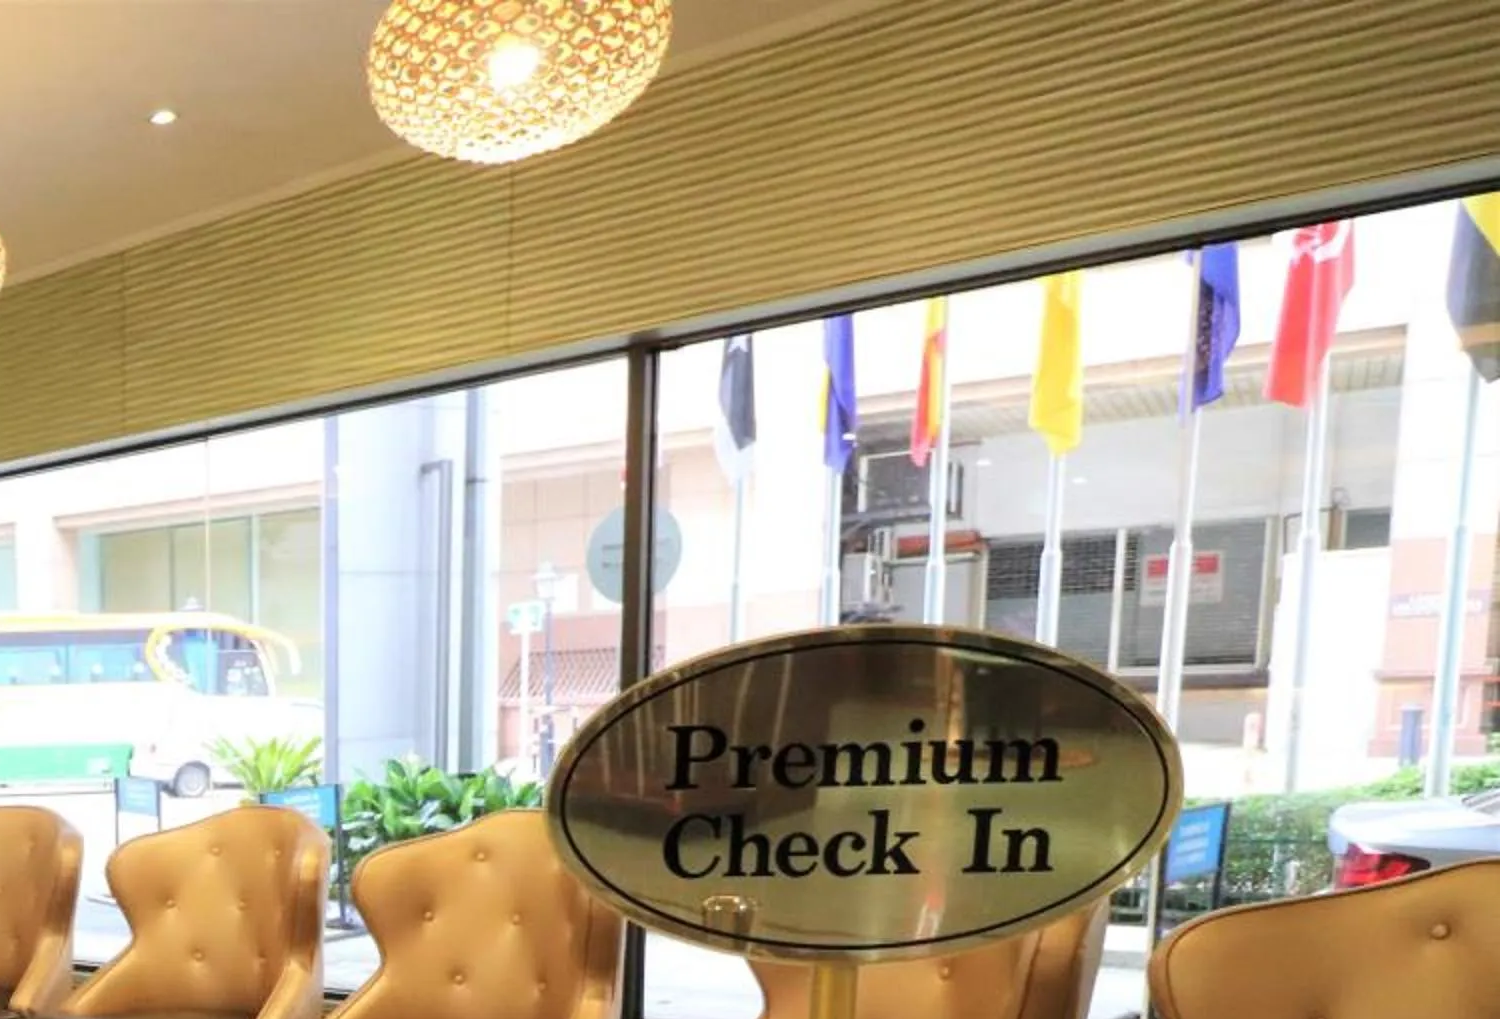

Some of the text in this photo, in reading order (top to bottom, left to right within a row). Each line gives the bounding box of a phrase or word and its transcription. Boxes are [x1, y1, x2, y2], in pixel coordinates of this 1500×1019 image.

[663, 718, 1063, 791] Premium
[662, 808, 1054, 878] Check In
